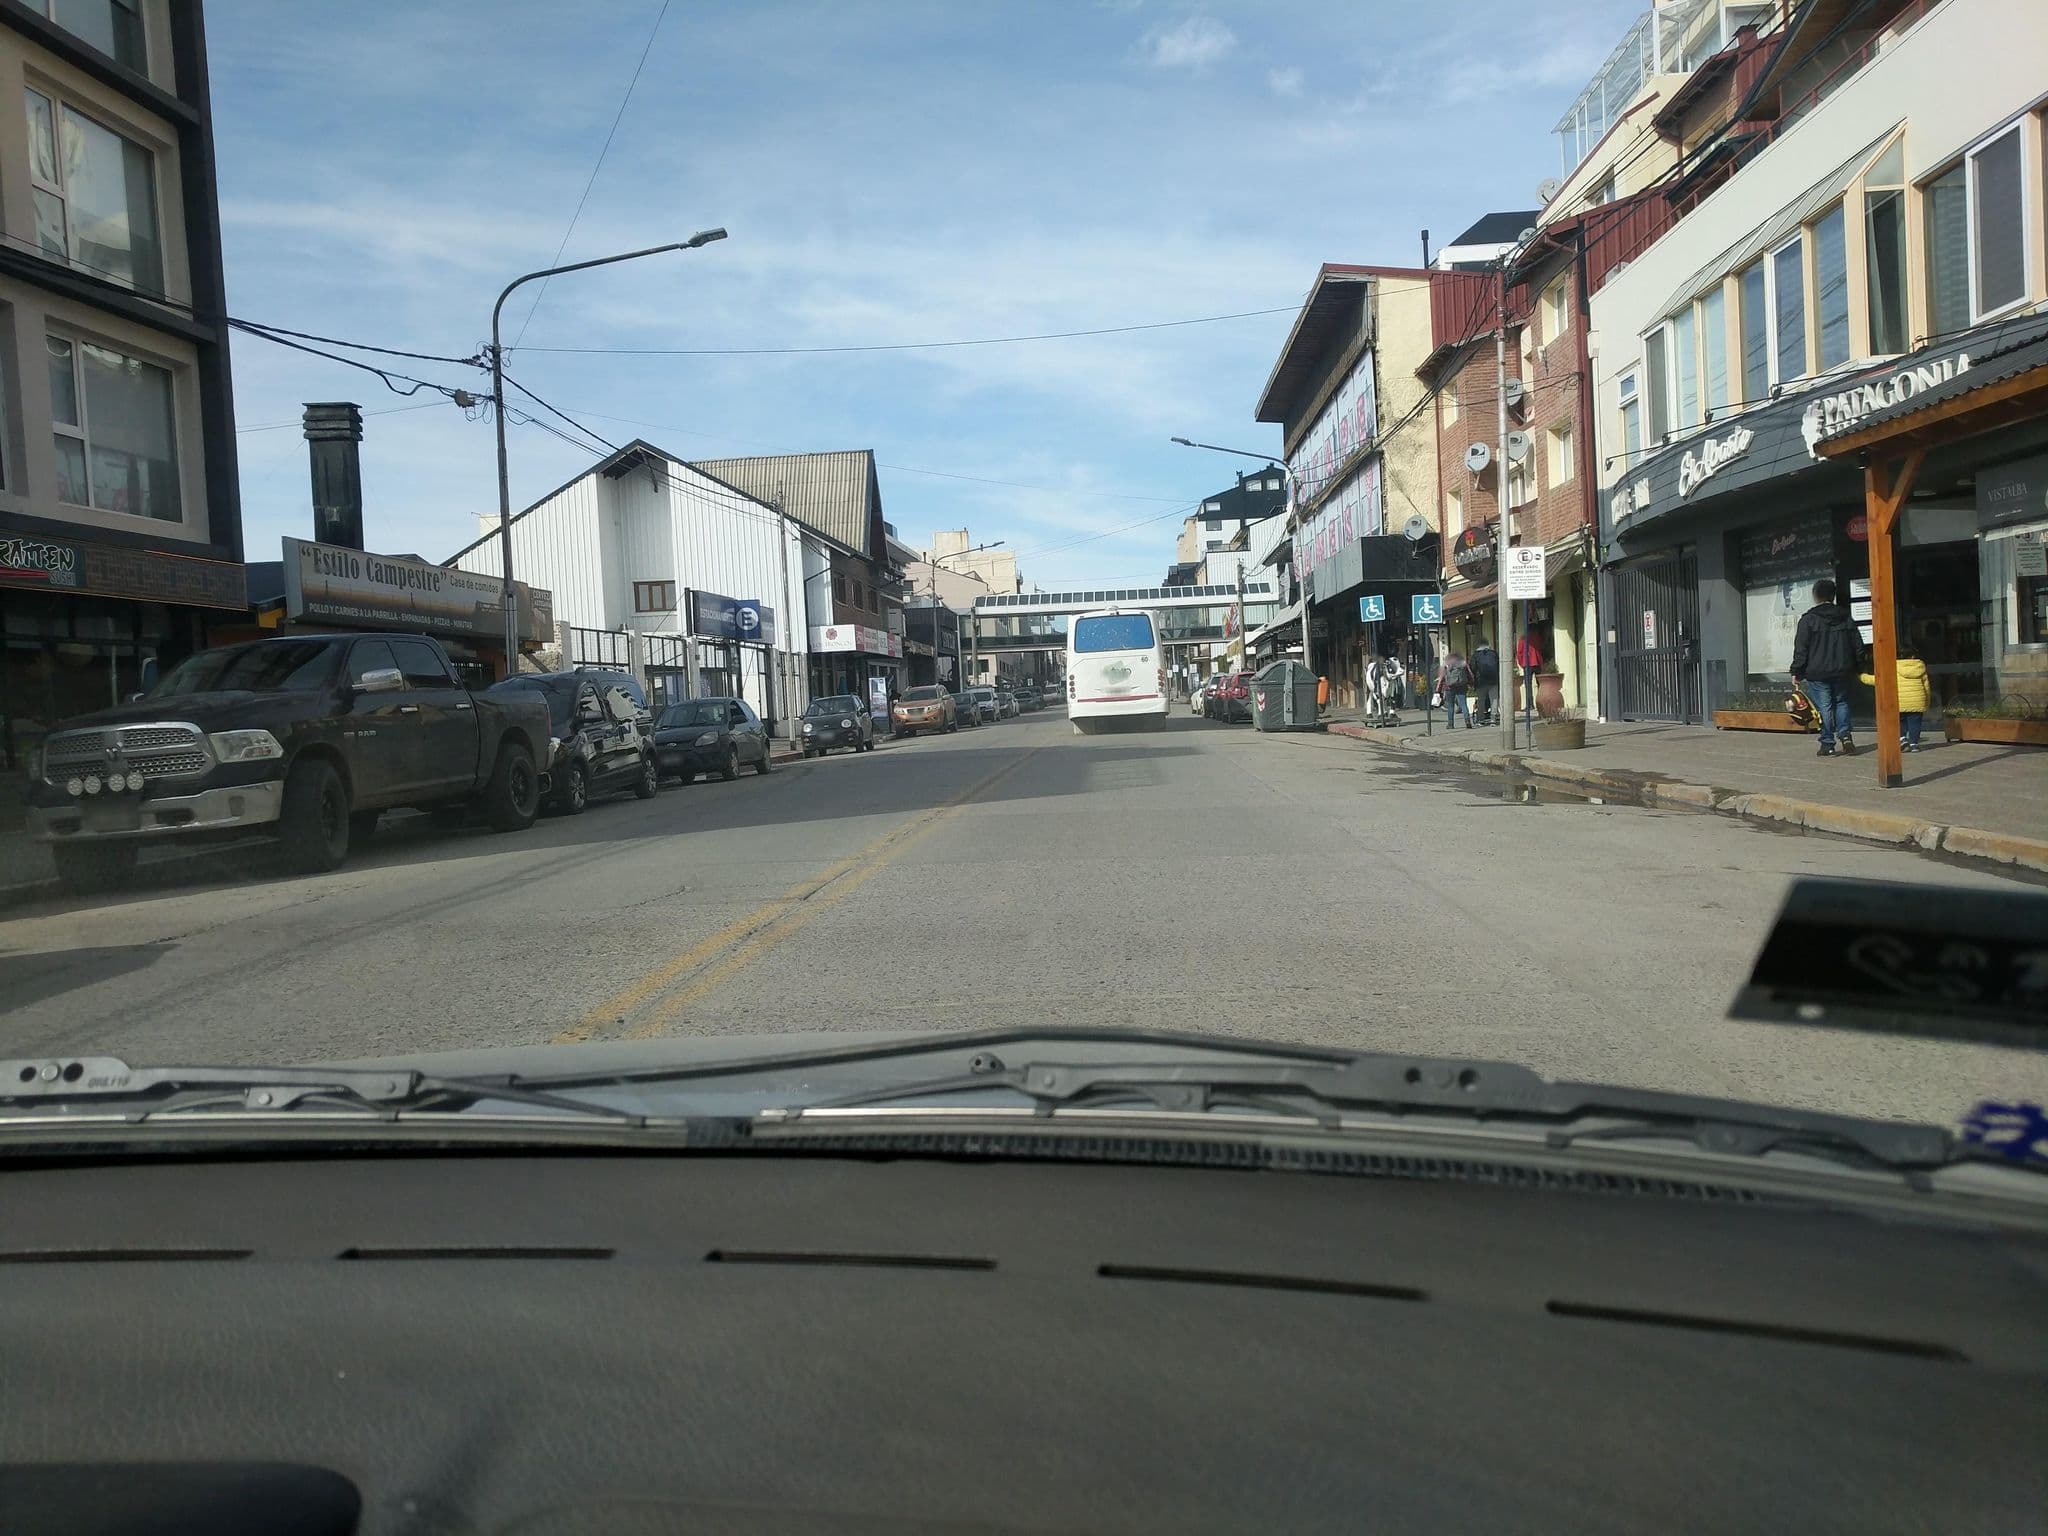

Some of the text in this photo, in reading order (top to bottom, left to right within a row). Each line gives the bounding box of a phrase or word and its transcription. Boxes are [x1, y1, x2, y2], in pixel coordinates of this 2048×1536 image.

[1821, 353, 1971, 425] PATAGONIA
[1987, 482, 2028, 502] VISTALBA
[1521, 551, 1529, 561] E
[50, 570, 76, 586] SUSHI
[450, 574, 499, 594] Casa de comidas
[309, 602, 329, 614] POLLO
[335, 605, 360, 617] CARNES
[372, 609, 398, 621] PARRILLA
[741, 611, 753, 626] E
